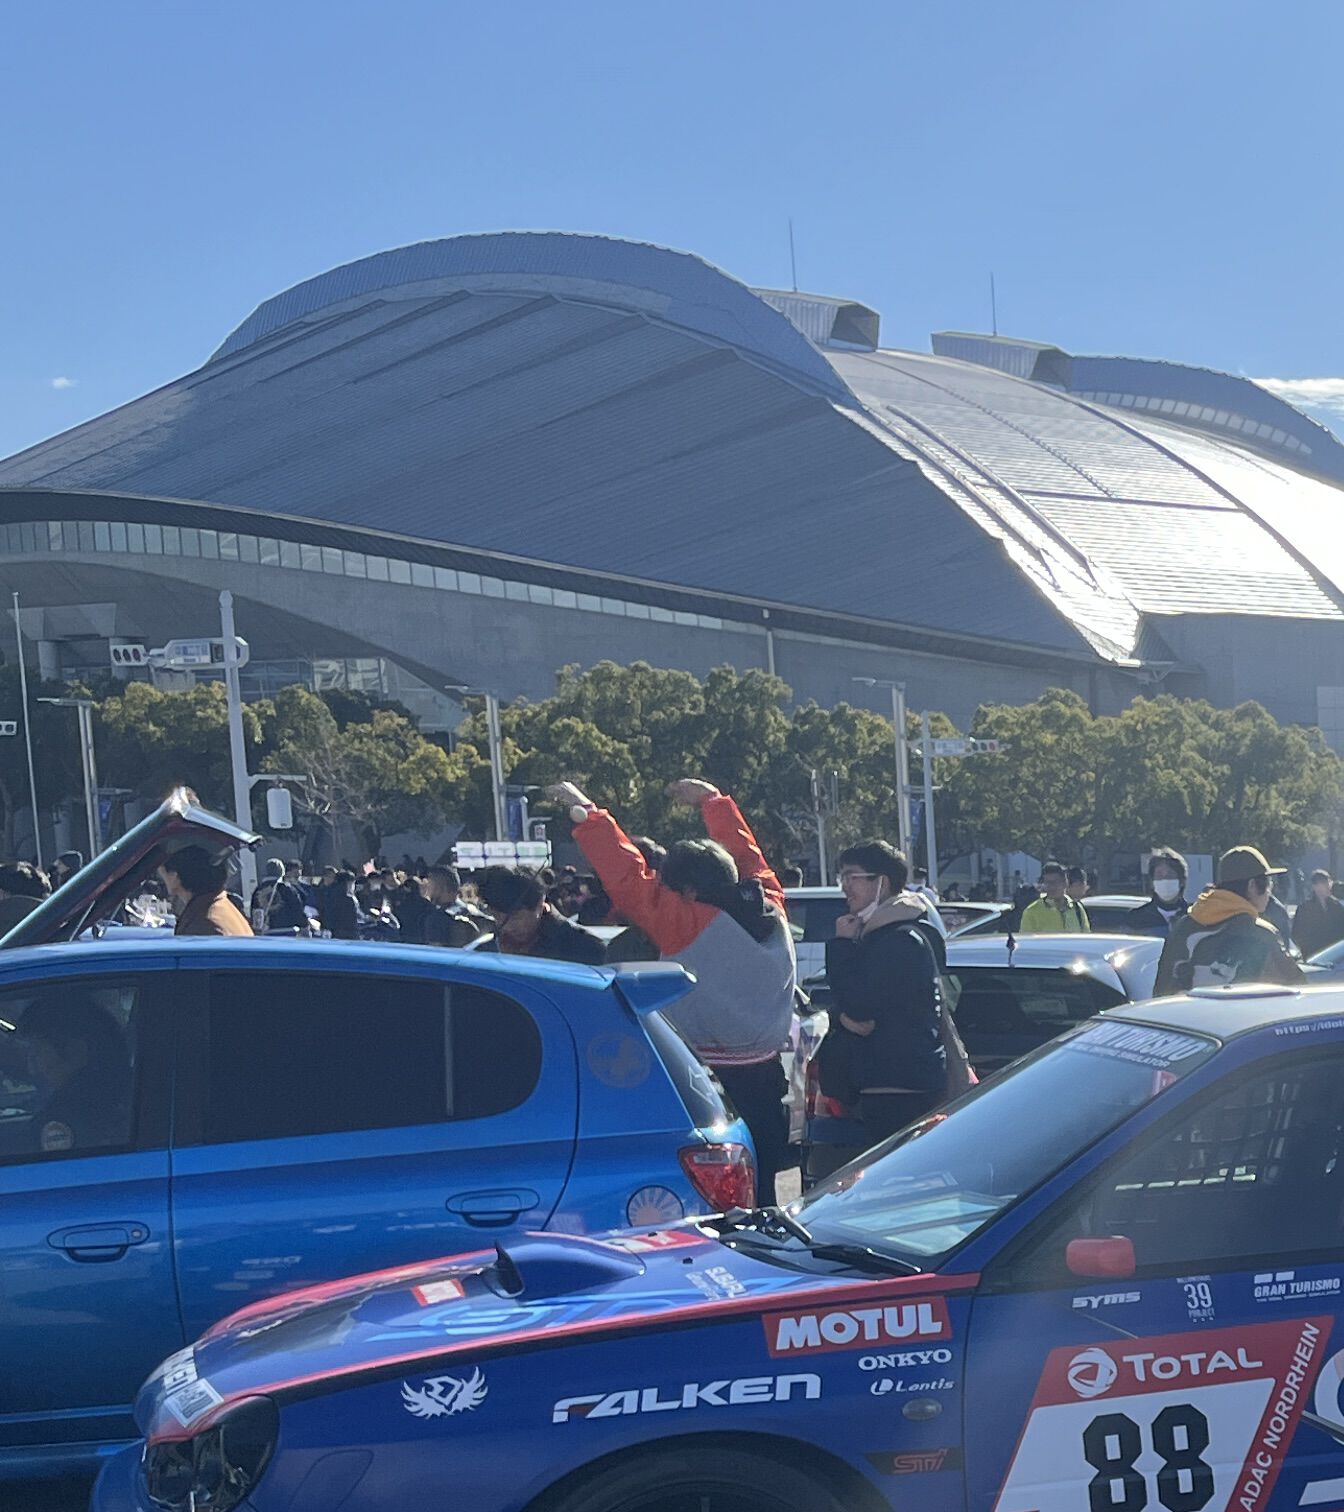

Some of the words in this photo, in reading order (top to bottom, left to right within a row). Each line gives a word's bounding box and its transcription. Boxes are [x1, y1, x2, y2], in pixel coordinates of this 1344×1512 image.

[1184, 1283, 1212, 1309] 39
[1254, 1284, 1286, 1298] GRAN
[1290, 1278, 1340, 1294] TURISMO
[776, 1303, 942, 1351] MOTUL
[858, 1348, 952, 1371] ONKYO
[1122, 1347, 1263, 1381] TOTAL
[552, 1373, 821, 1424] FALKEN
[896, 1377, 955, 1393] Lantis
[1238, 1451, 1273, 1512] ADAC
[1263, 1322, 1320, 1450] NORDRHEIN
